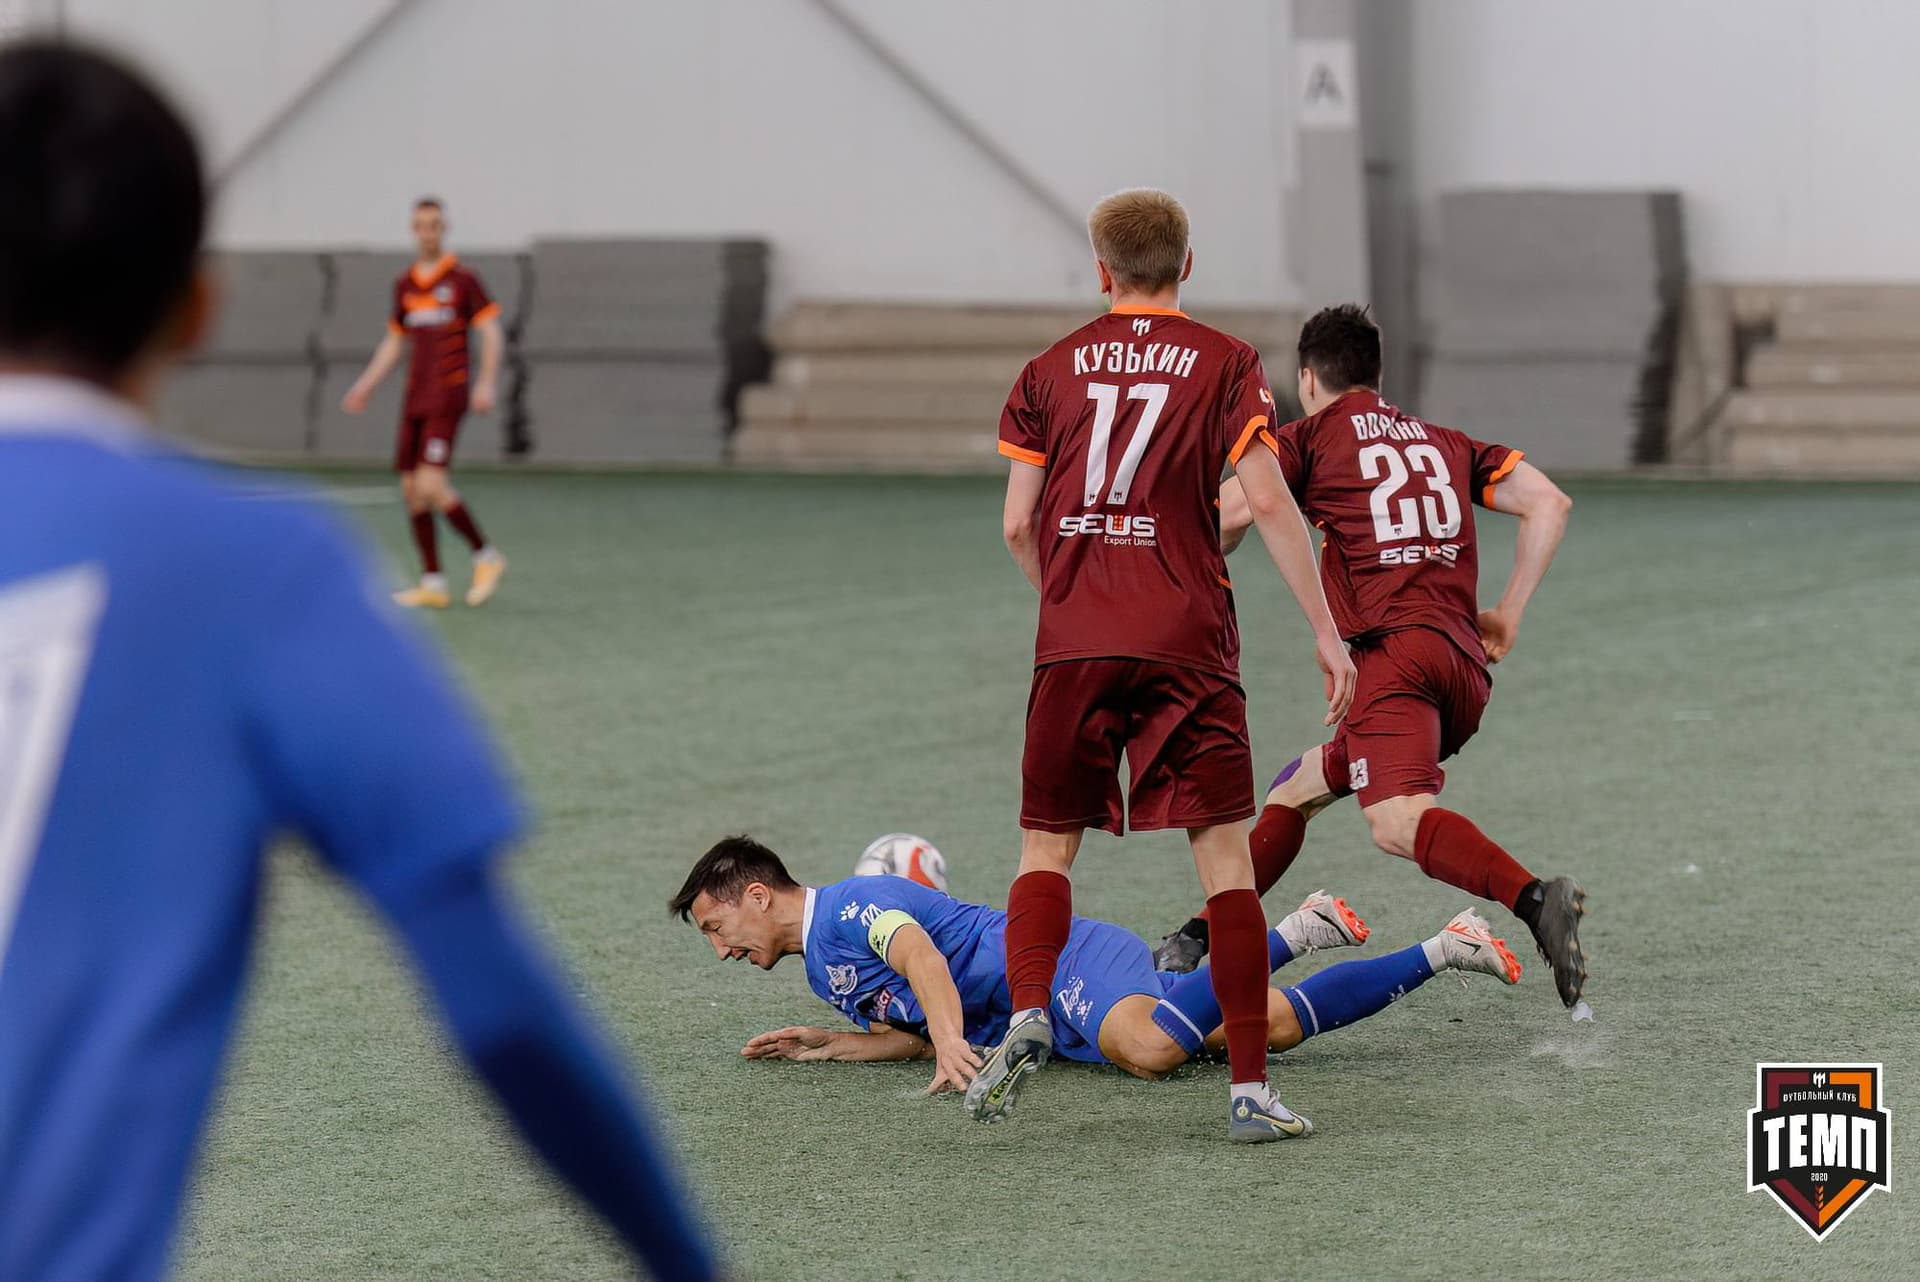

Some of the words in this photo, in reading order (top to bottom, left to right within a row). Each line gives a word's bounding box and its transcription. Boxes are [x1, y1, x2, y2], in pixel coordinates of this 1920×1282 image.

[1074, 342, 1198, 378] КУЗЬКИН
[1083, 382, 1170, 507] 17
[1358, 443, 1462, 543] 23
[1058, 513, 1156, 537] SEUS
[1104, 535, 1131, 546] Export
[1133, 537, 1157, 547] Union
